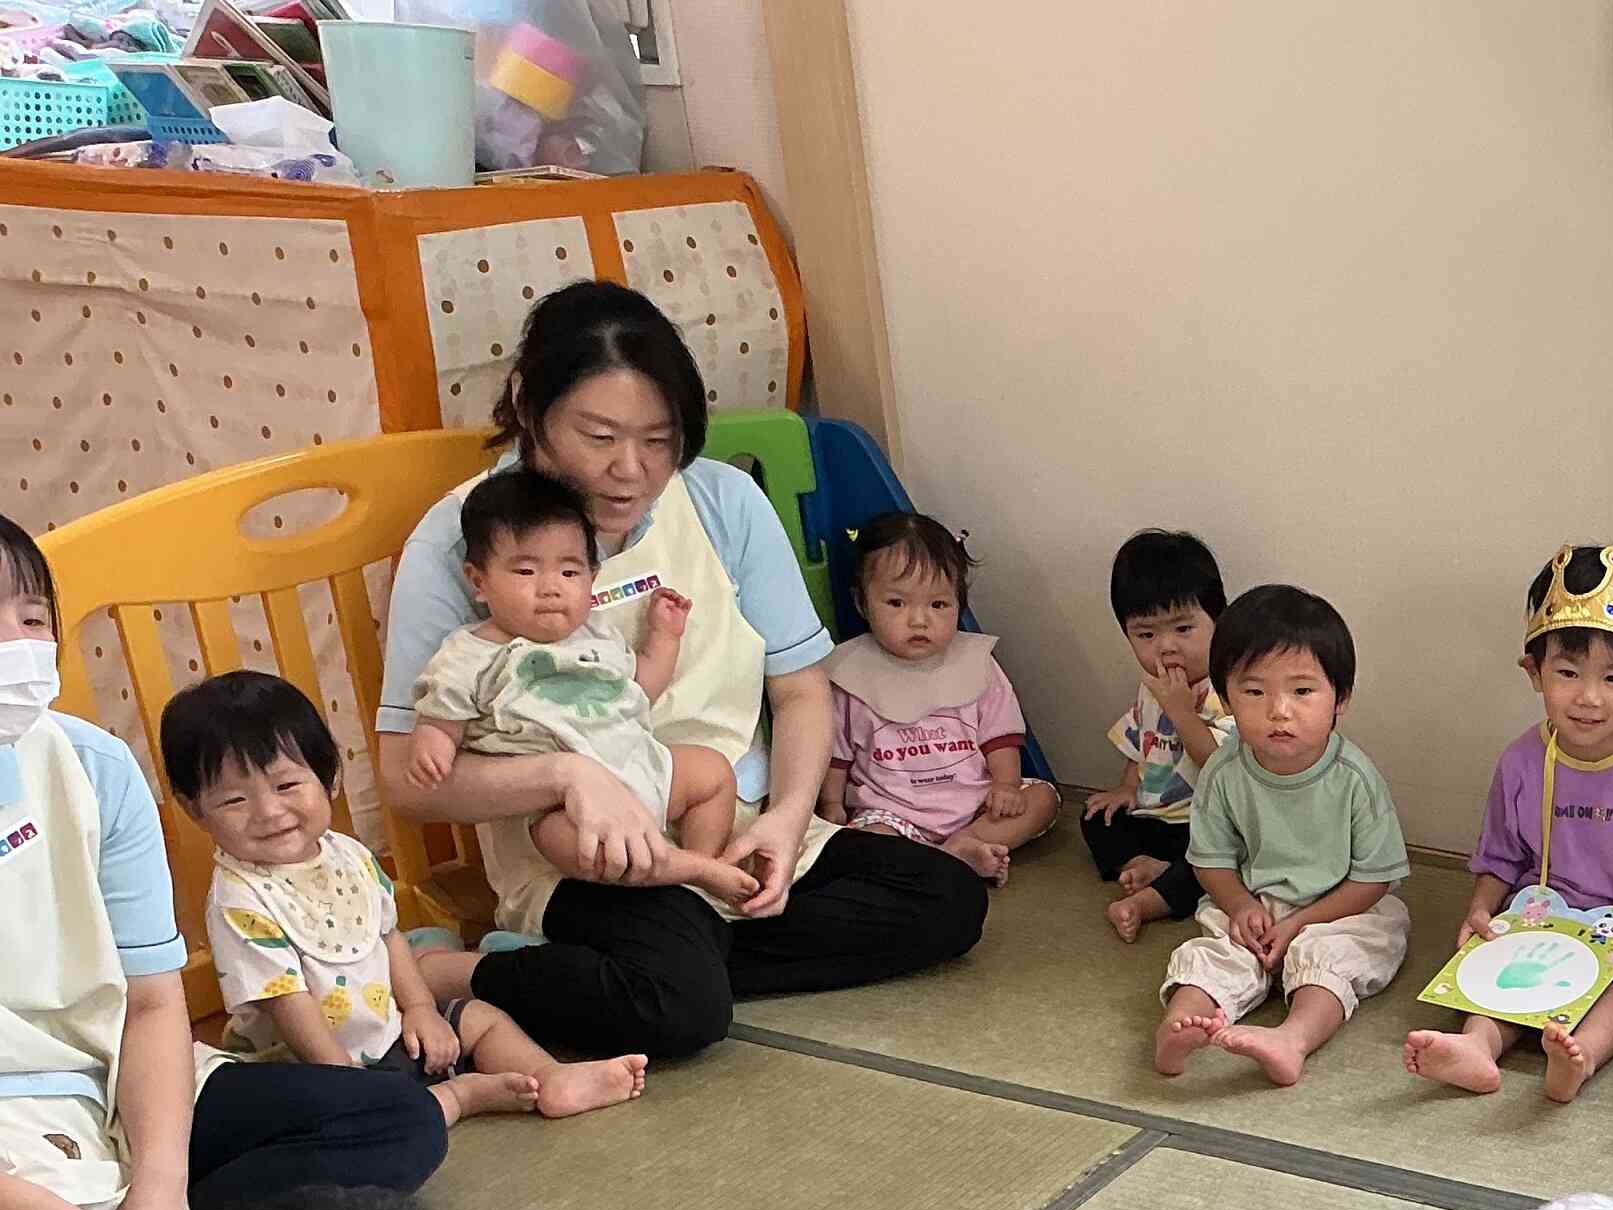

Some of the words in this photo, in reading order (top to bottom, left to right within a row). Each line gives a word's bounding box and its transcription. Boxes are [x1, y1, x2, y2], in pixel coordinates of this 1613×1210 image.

[896, 726, 946, 743] What
[873, 748, 894, 761] do
[896, 745, 931, 761] you
[935, 740, 977, 752] want
